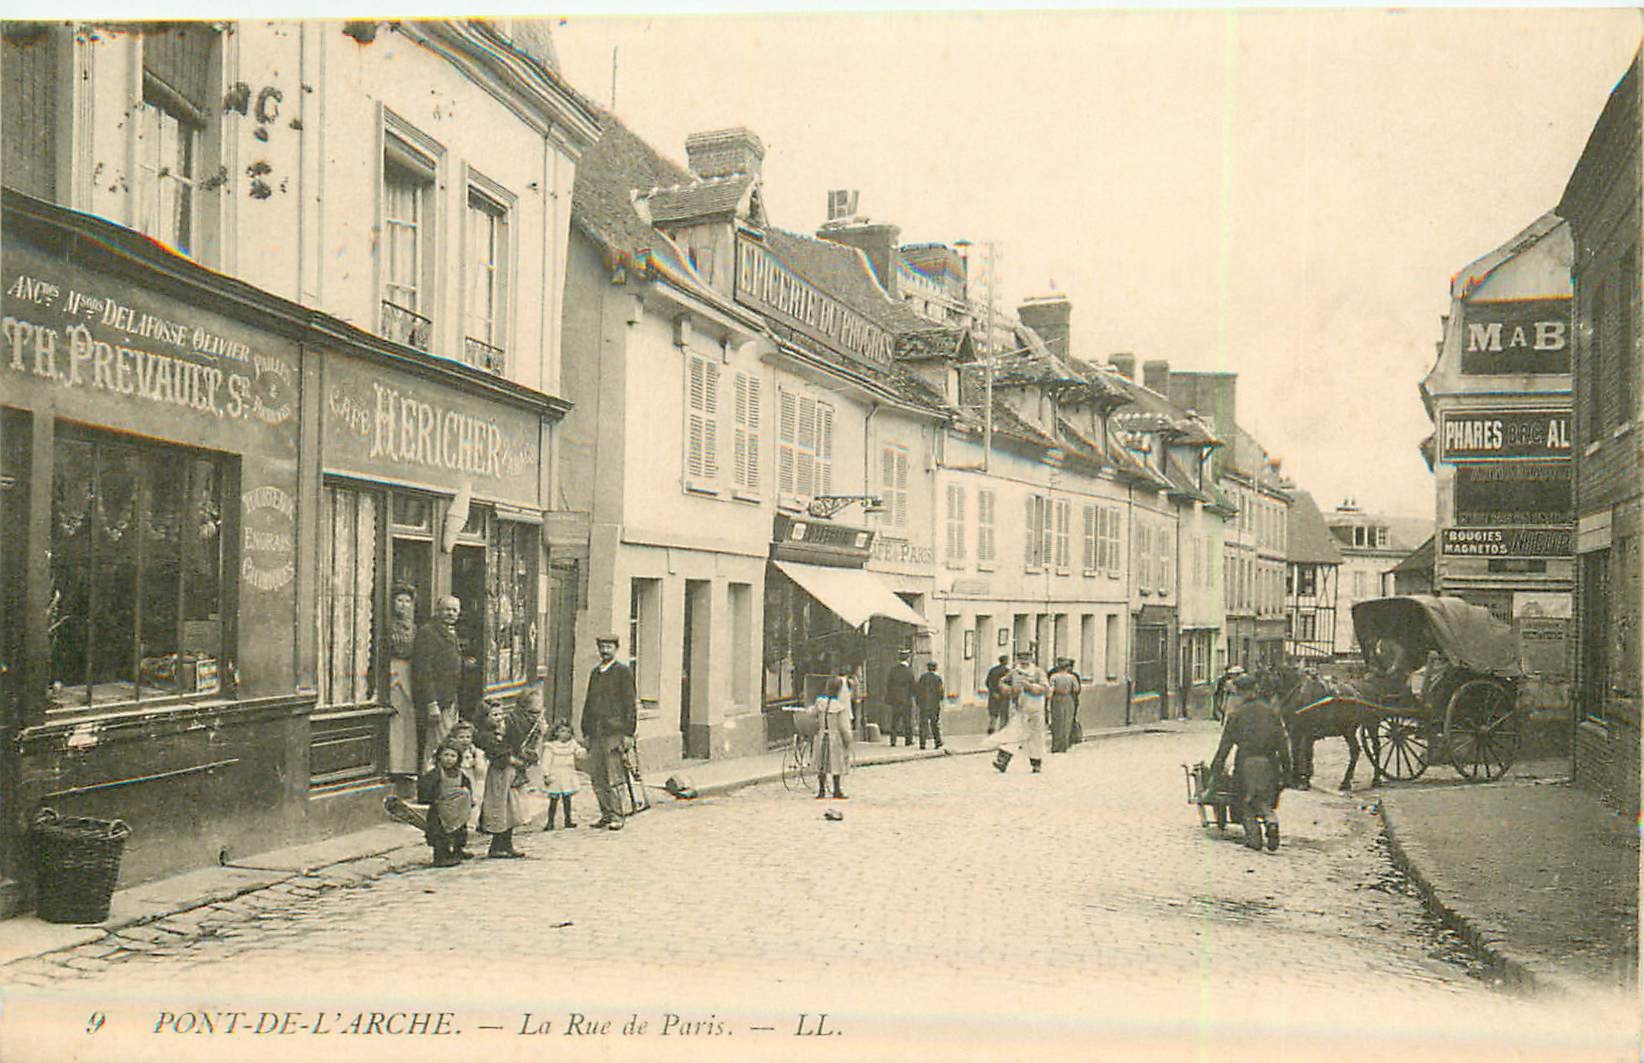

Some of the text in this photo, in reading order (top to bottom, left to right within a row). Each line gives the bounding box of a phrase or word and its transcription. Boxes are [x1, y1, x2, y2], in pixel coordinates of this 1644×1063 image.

[101, 298, 188, 347] DELAFOSSE
[192, 326, 251, 362] OLIVIER
[1446, 420, 1503, 450] PHARES
[1449, 531, 1503, 542] BOUGIES
[1444, 543, 1508, 555] MAGNETOS
